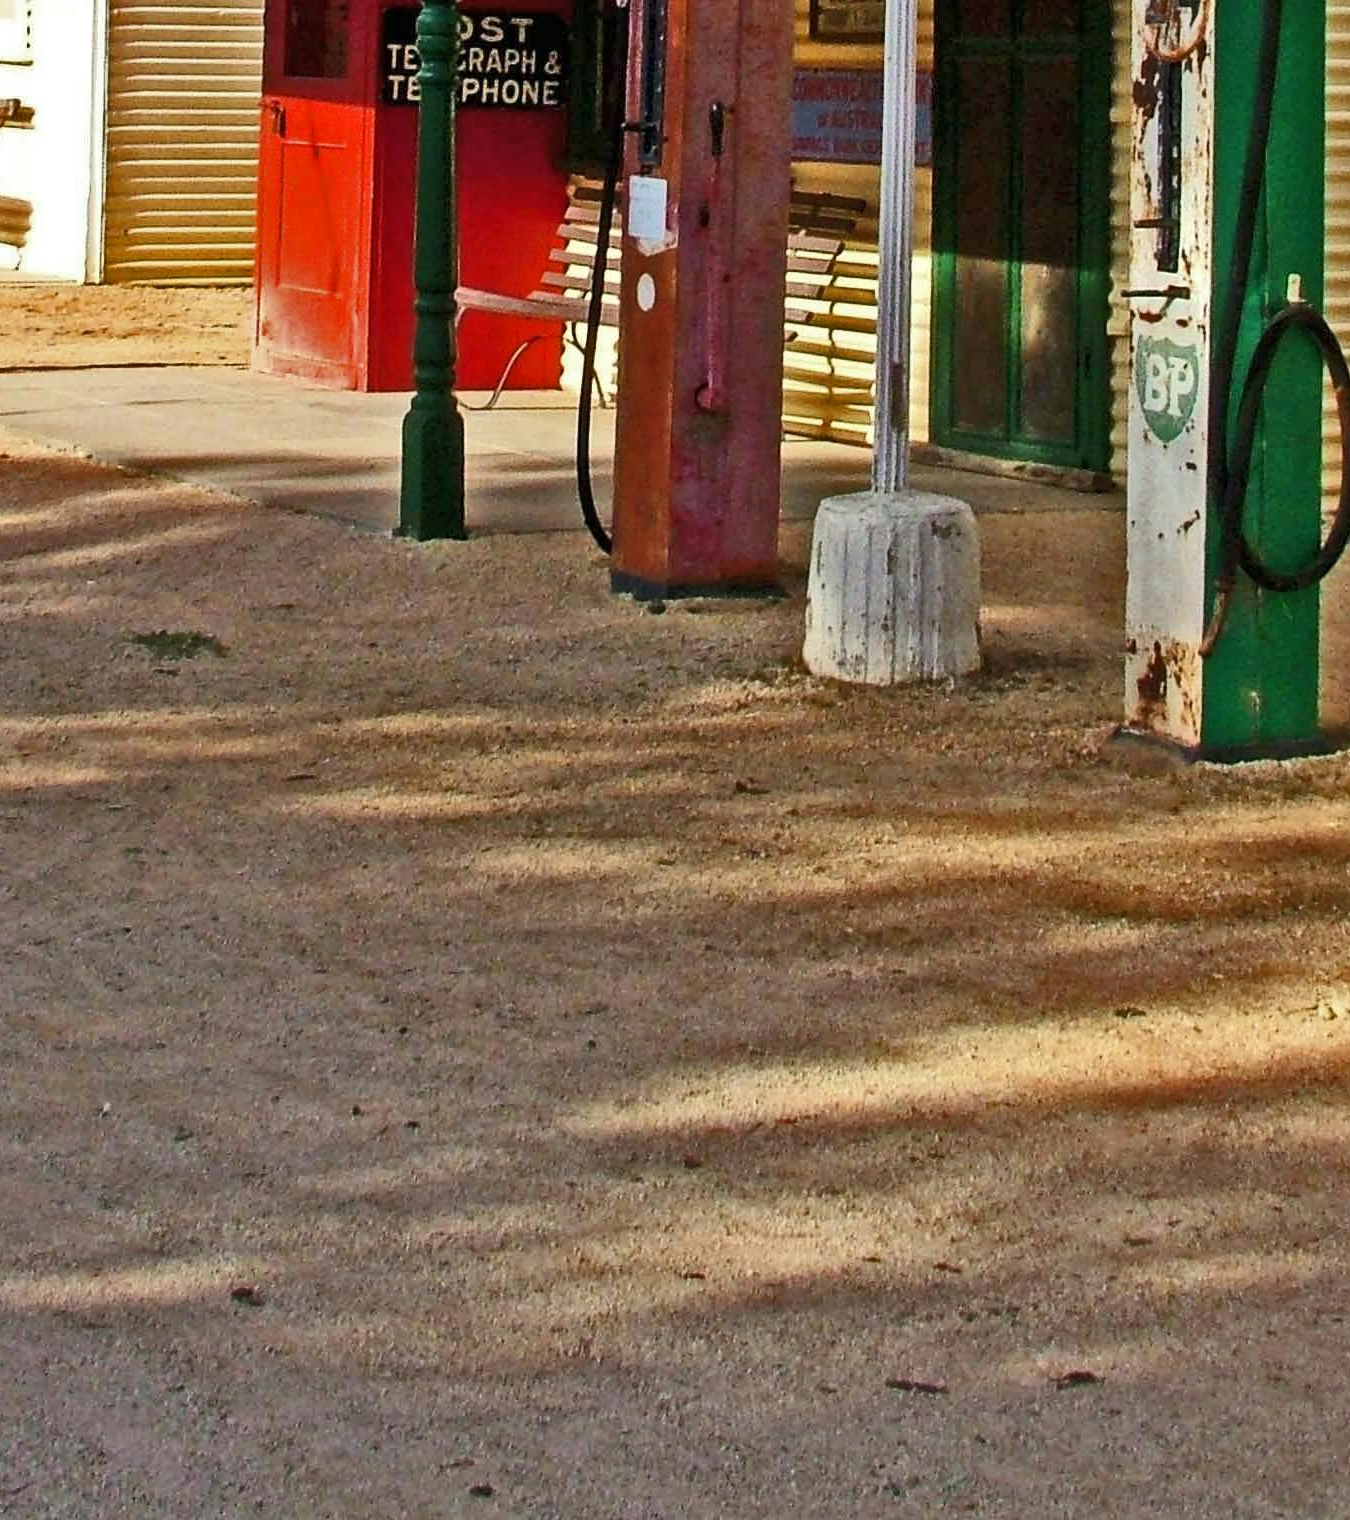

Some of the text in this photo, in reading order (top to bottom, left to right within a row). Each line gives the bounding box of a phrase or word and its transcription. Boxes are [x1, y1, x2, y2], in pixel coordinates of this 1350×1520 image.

[454, 15, 534, 44] OST
[386, 44, 563, 75] TEGRAPH &
[387, 75, 560, 106] TEPHONE
[1142, 352, 1195, 417] BP
